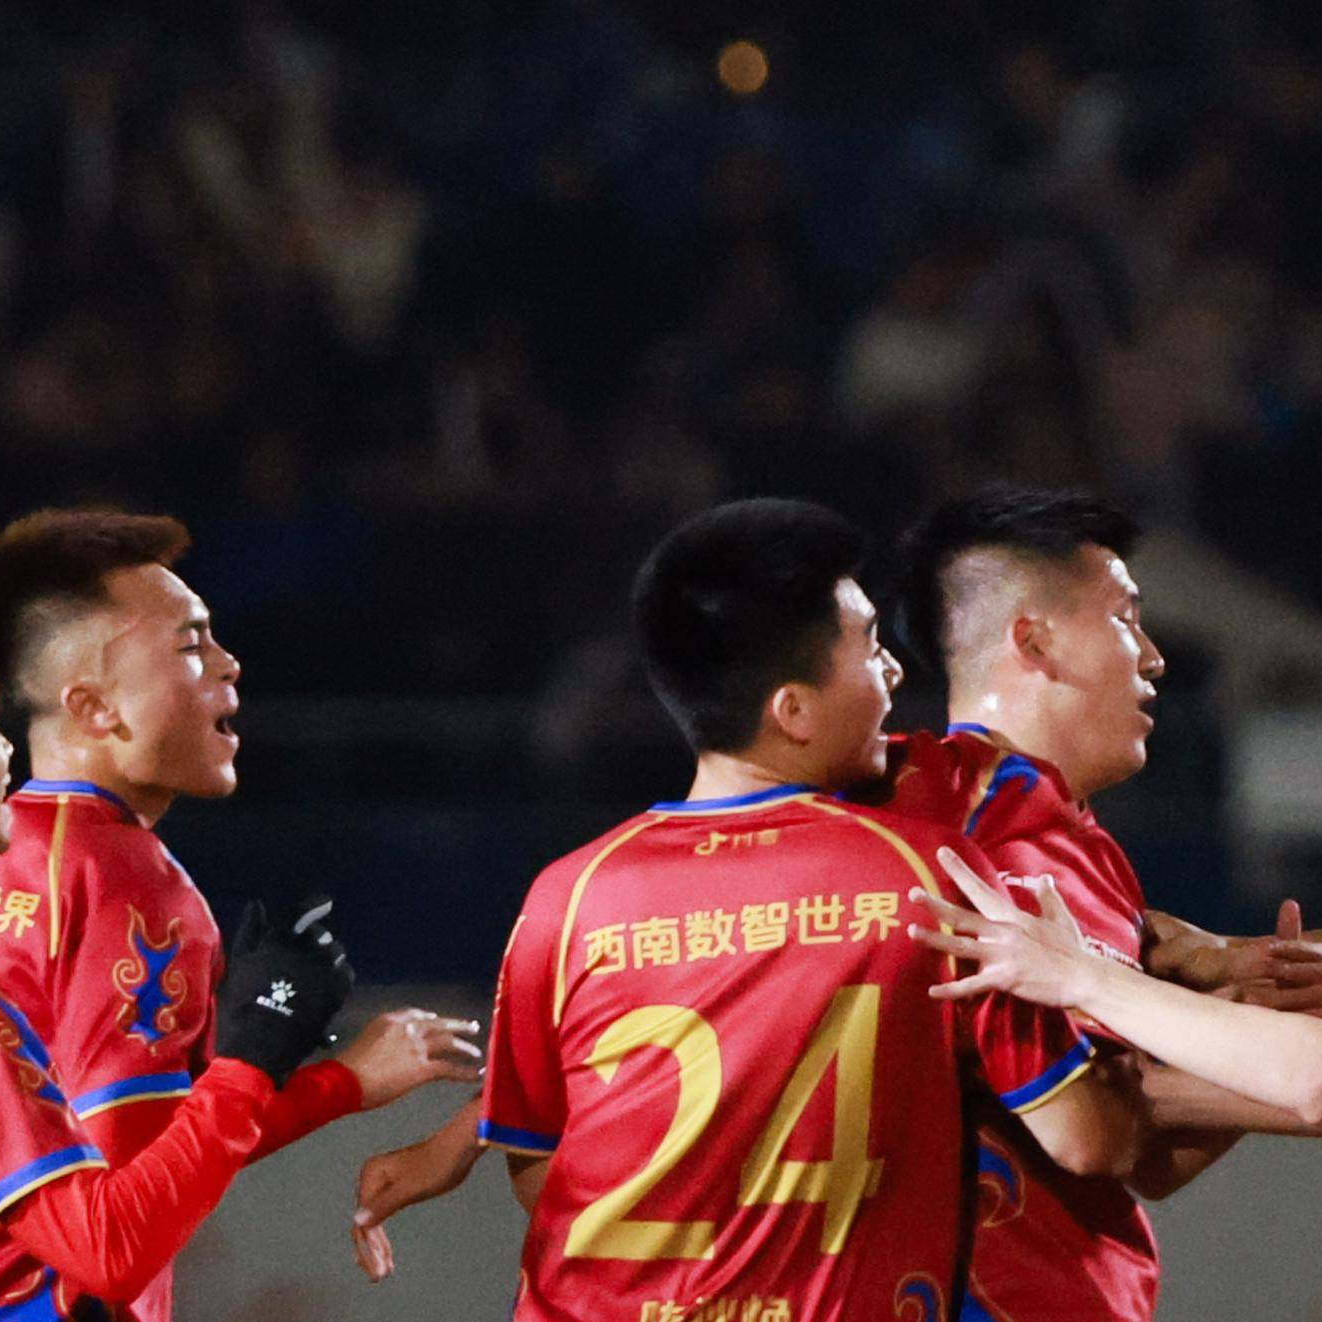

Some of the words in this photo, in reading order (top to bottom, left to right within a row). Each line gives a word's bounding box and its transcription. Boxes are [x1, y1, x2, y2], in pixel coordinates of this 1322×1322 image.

[583, 891, 900, 975] 西南数智世界
[563, 984, 885, 1260] 24
